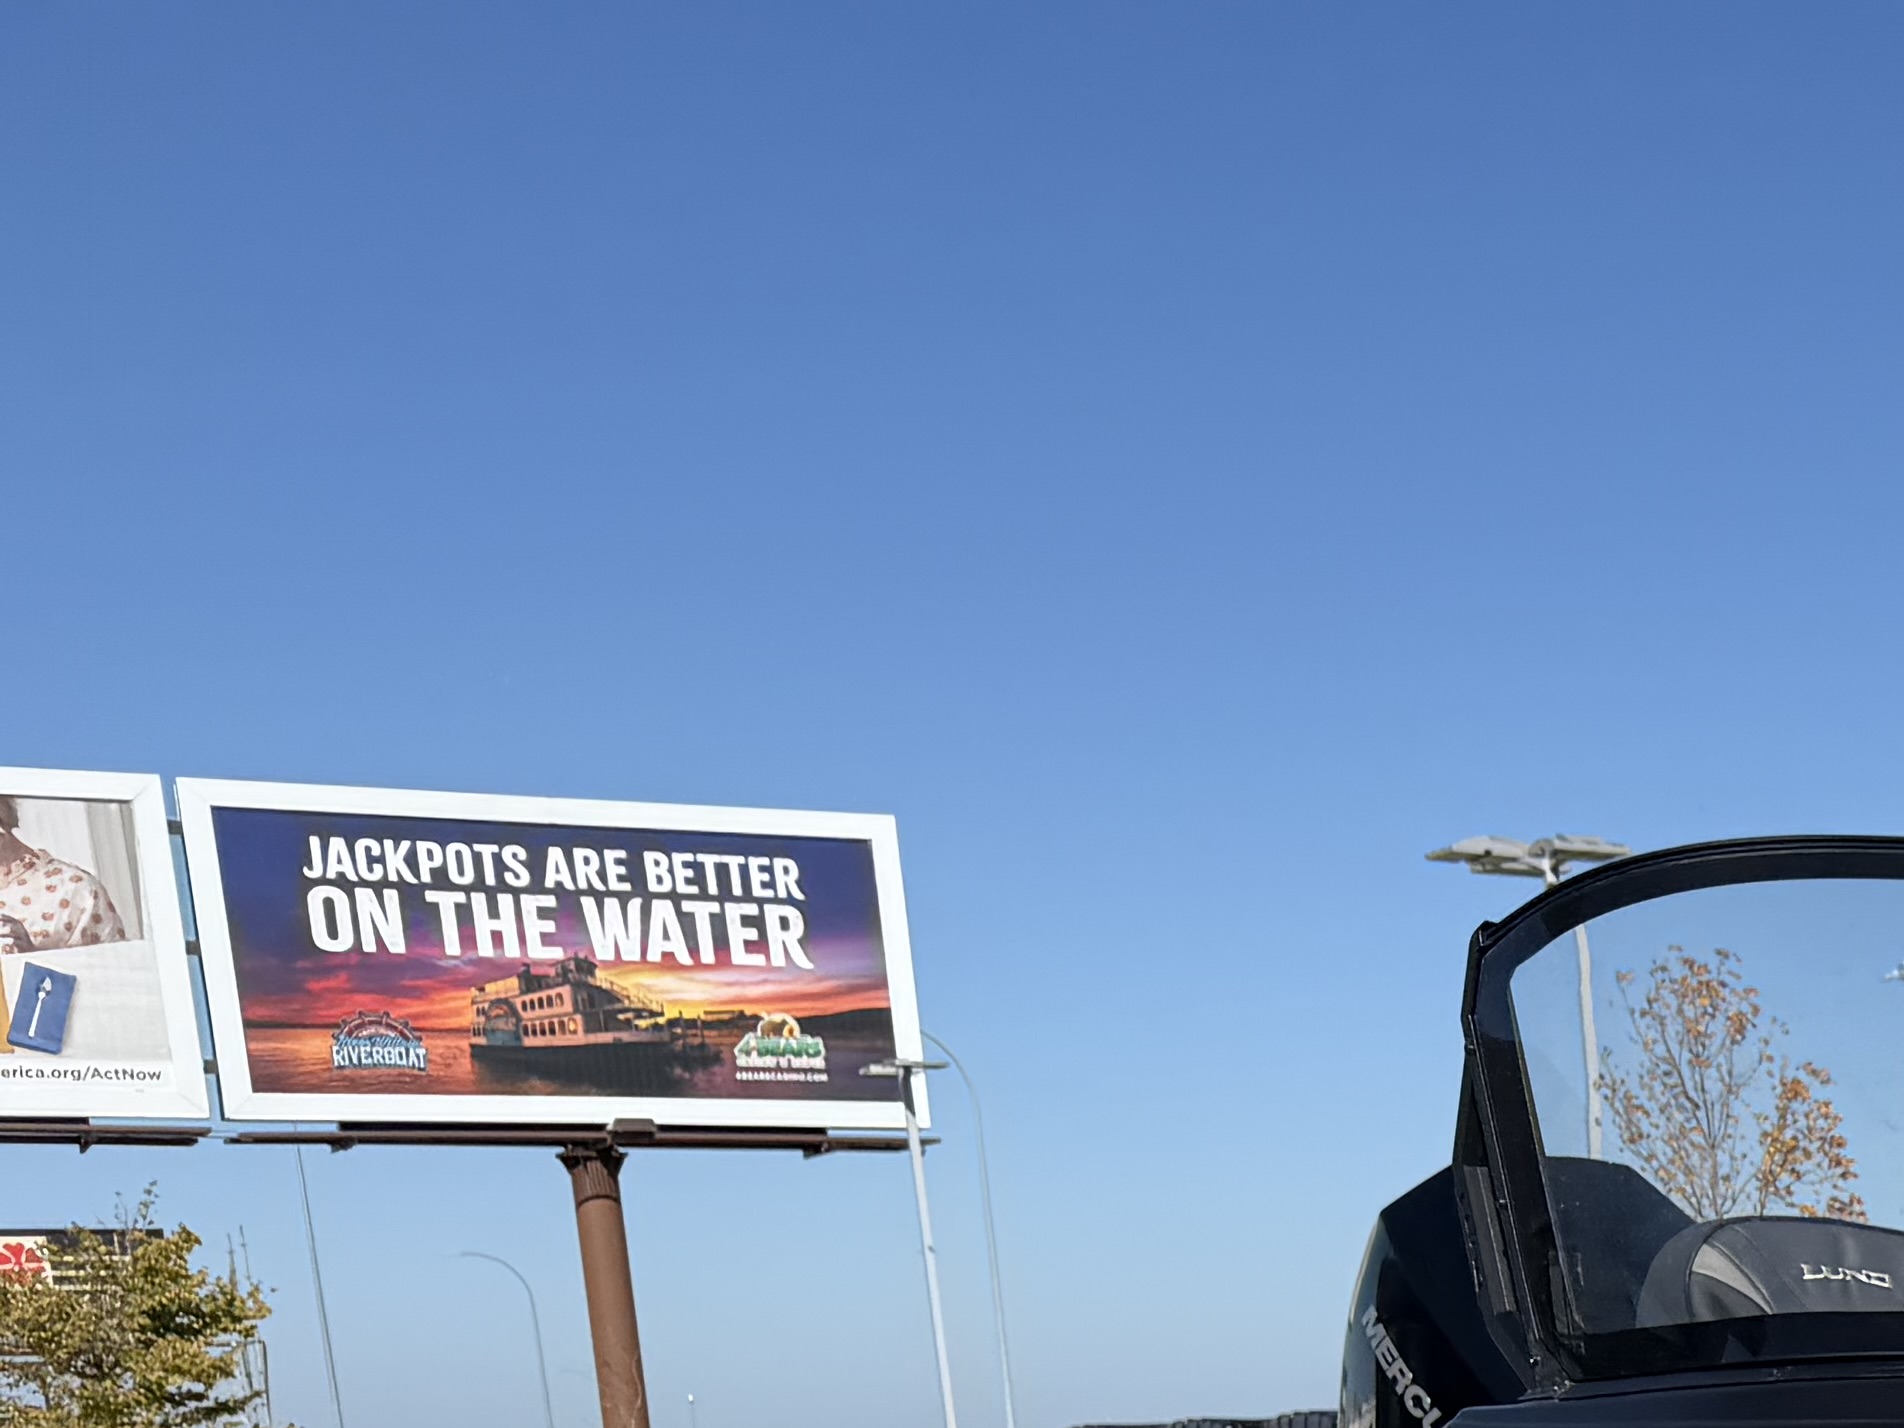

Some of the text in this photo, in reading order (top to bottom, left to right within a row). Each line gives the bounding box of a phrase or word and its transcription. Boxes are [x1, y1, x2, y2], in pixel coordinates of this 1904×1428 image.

[302, 835, 806, 901] JACKPOTS ARE BETTER
[306, 885, 815, 970] ON THE WATER
[331, 1044, 427, 1069] RIVERBOAT
[1800, 1263, 1893, 1290] LUND
